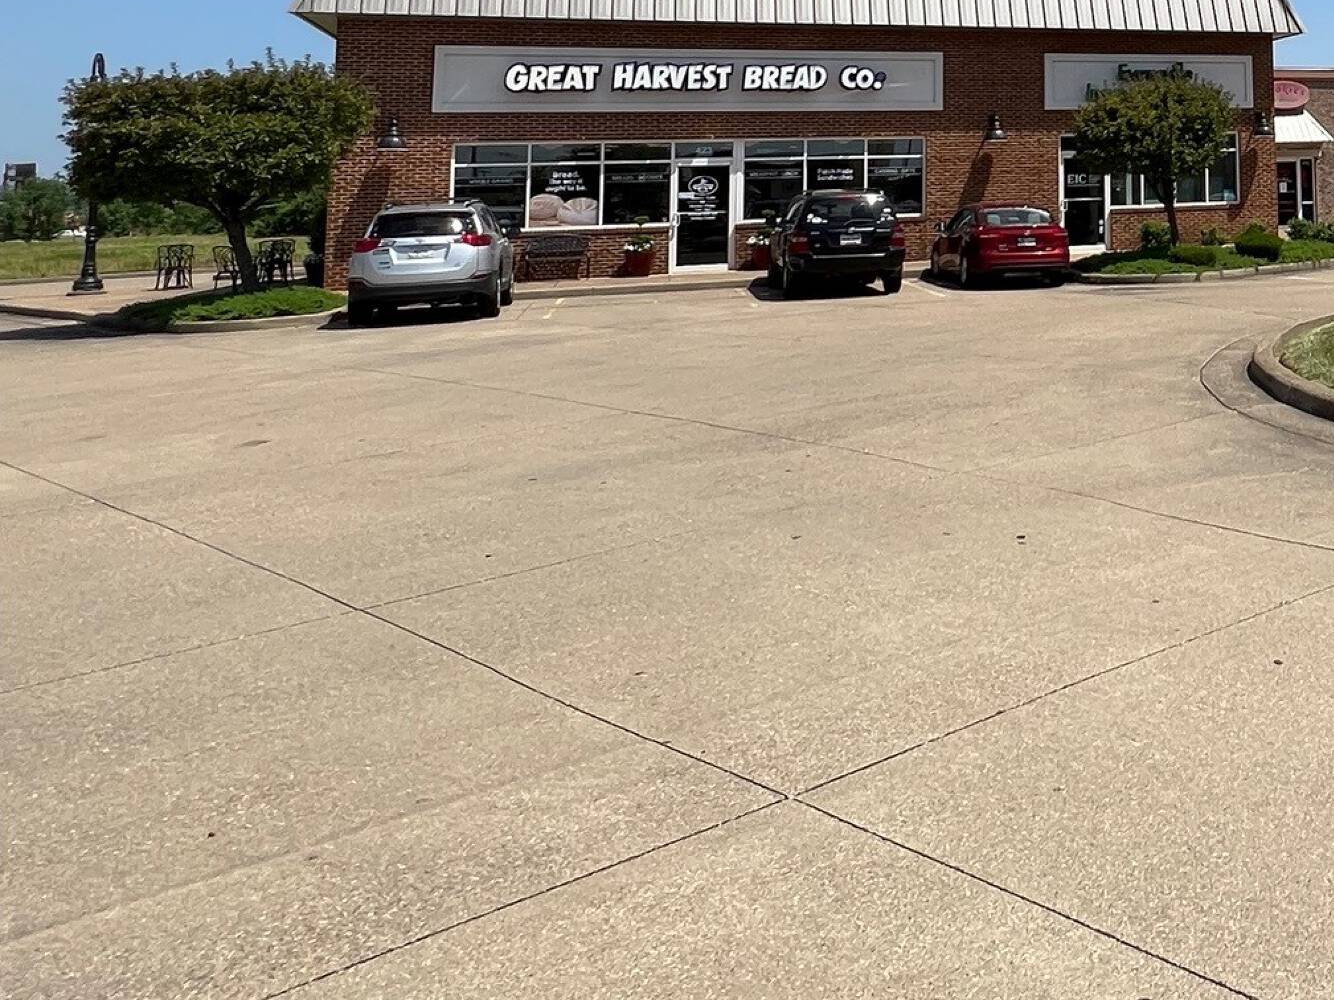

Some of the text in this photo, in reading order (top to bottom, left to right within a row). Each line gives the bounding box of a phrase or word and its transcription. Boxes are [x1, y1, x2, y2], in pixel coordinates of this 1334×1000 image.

[505, 63, 600, 92] GREAT
[612, 62, 734, 92] HARVEST
[742, 63, 828, 92] BREAD
